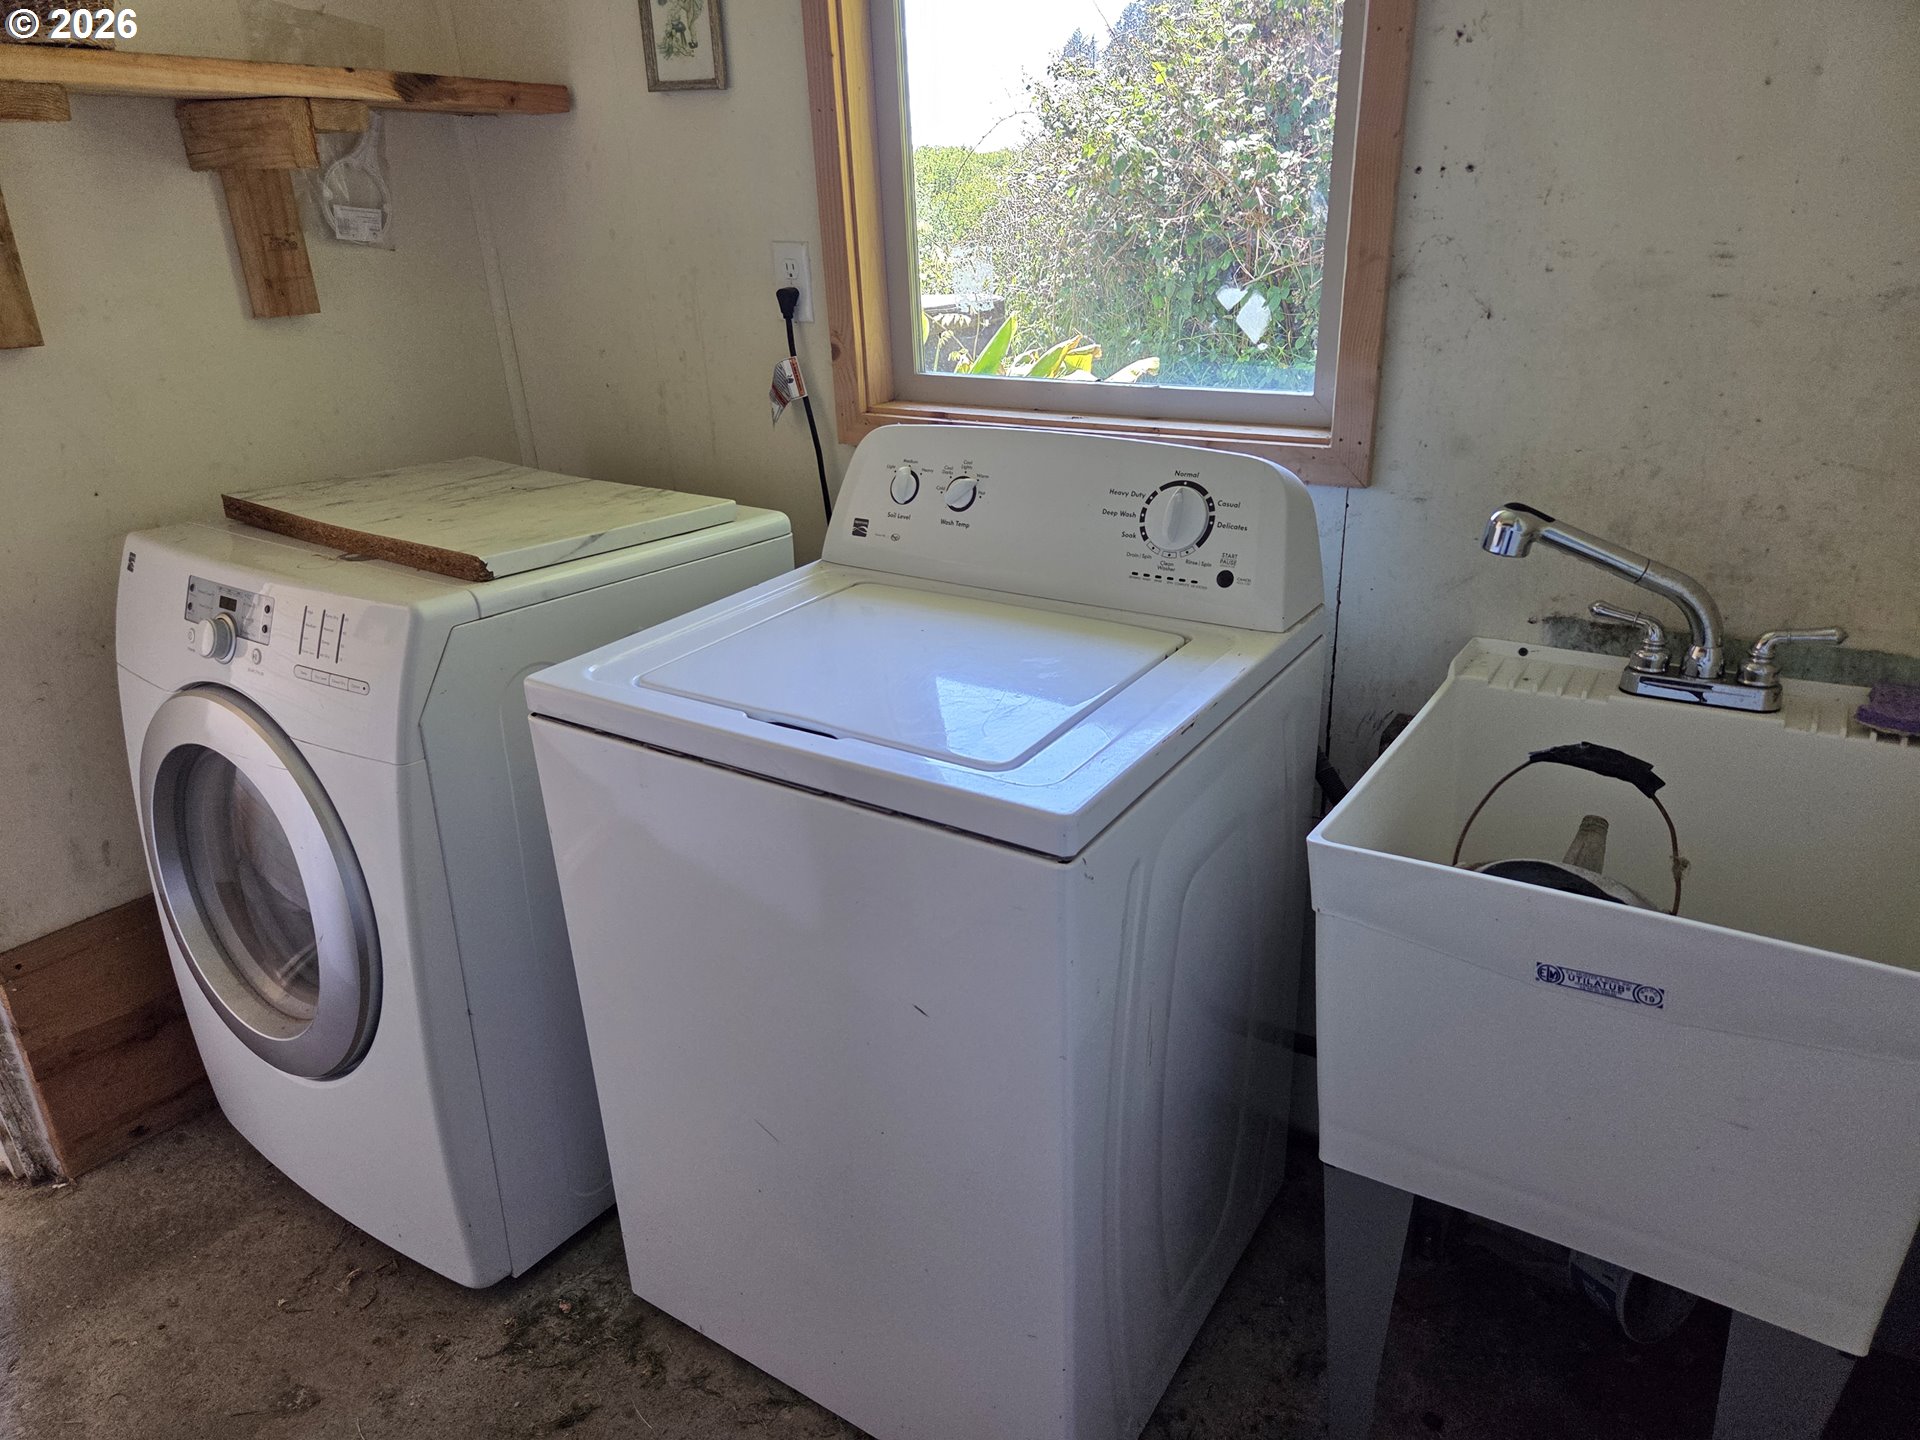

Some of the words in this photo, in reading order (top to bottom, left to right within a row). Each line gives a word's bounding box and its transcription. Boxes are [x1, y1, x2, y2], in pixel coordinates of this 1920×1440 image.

[1174, 470, 1200, 478] Normal
[1109, 488, 1130, 498] Heavy
[1130, 491, 1146, 499] Duty
[1217, 499, 1241, 508] Casual
[897, 513, 911, 521] Level
[1102, 508, 1118, 517] Deep
[1120, 510, 1137, 518] Wash
[941, 518, 955, 526] Wash
[956, 520, 970, 529] Temp
[1217, 521, 1248, 532] Delicates
[1121, 530, 1137, 539] Soak
[1219, 558, 1237, 567] PAUSE
